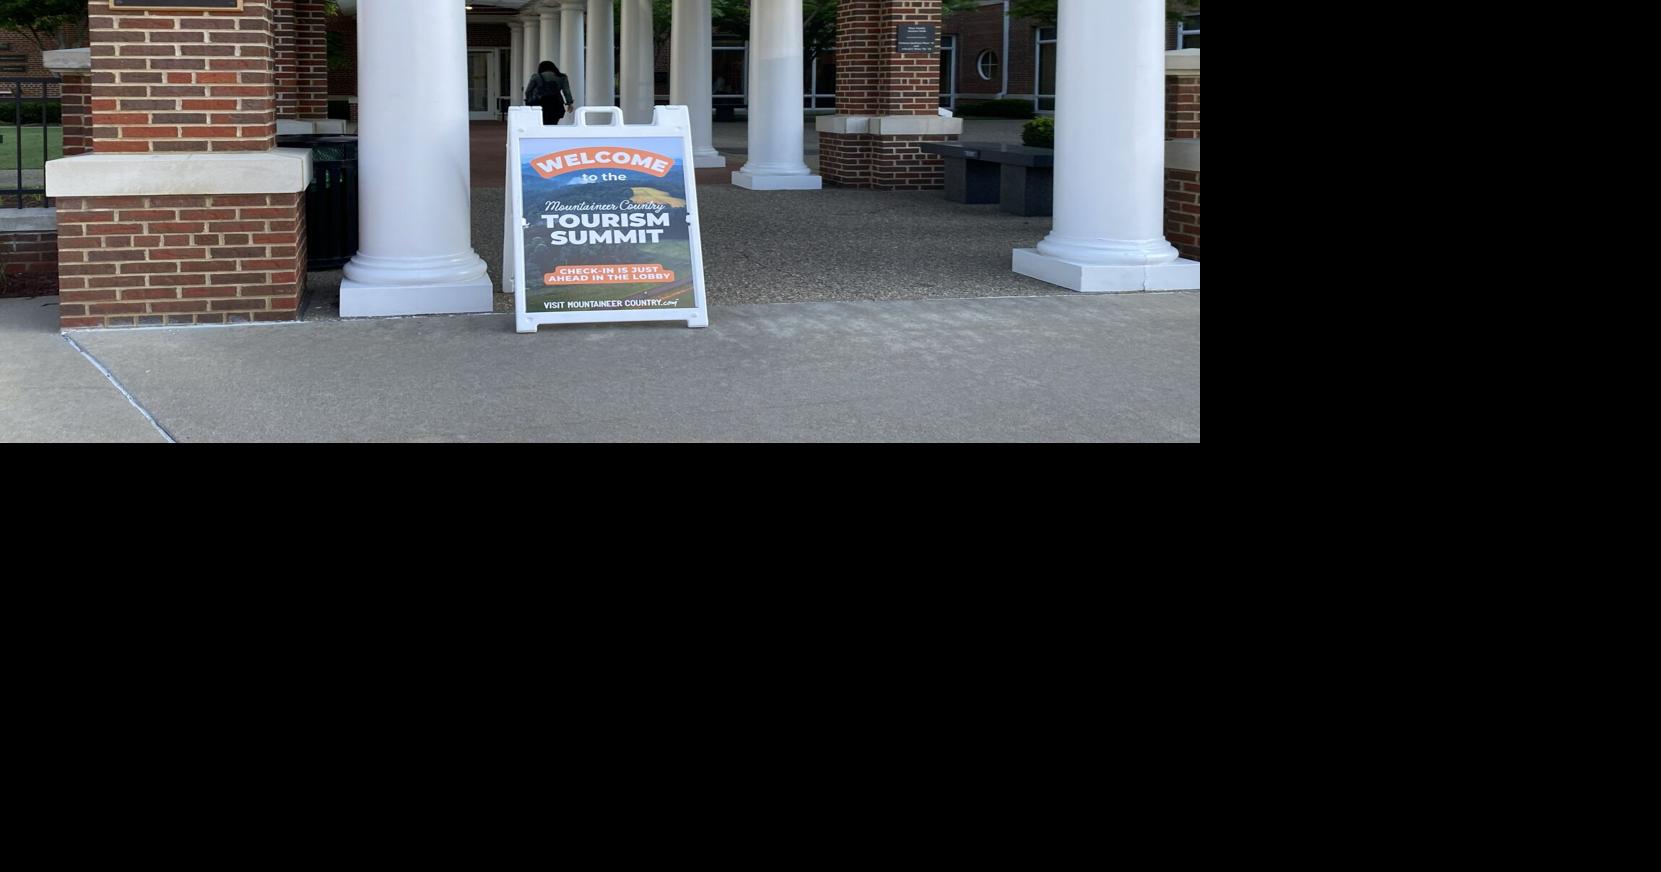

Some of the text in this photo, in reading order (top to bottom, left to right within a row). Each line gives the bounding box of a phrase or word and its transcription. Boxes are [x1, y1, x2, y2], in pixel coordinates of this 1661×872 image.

[537, 151, 669, 173] WELCOME
[582, 173, 627, 181] to the
[545, 200, 666, 214] Mountaineer Country
[541, 212, 670, 228] TOURISM
[550, 229, 664, 245] SUMMIT
[560, 266, 614, 275] CHECK-IN
[617, 266, 628, 274] IS
[543, 301, 565, 309] VISIT
[567, 300, 622, 308] MOUNTAINEER
